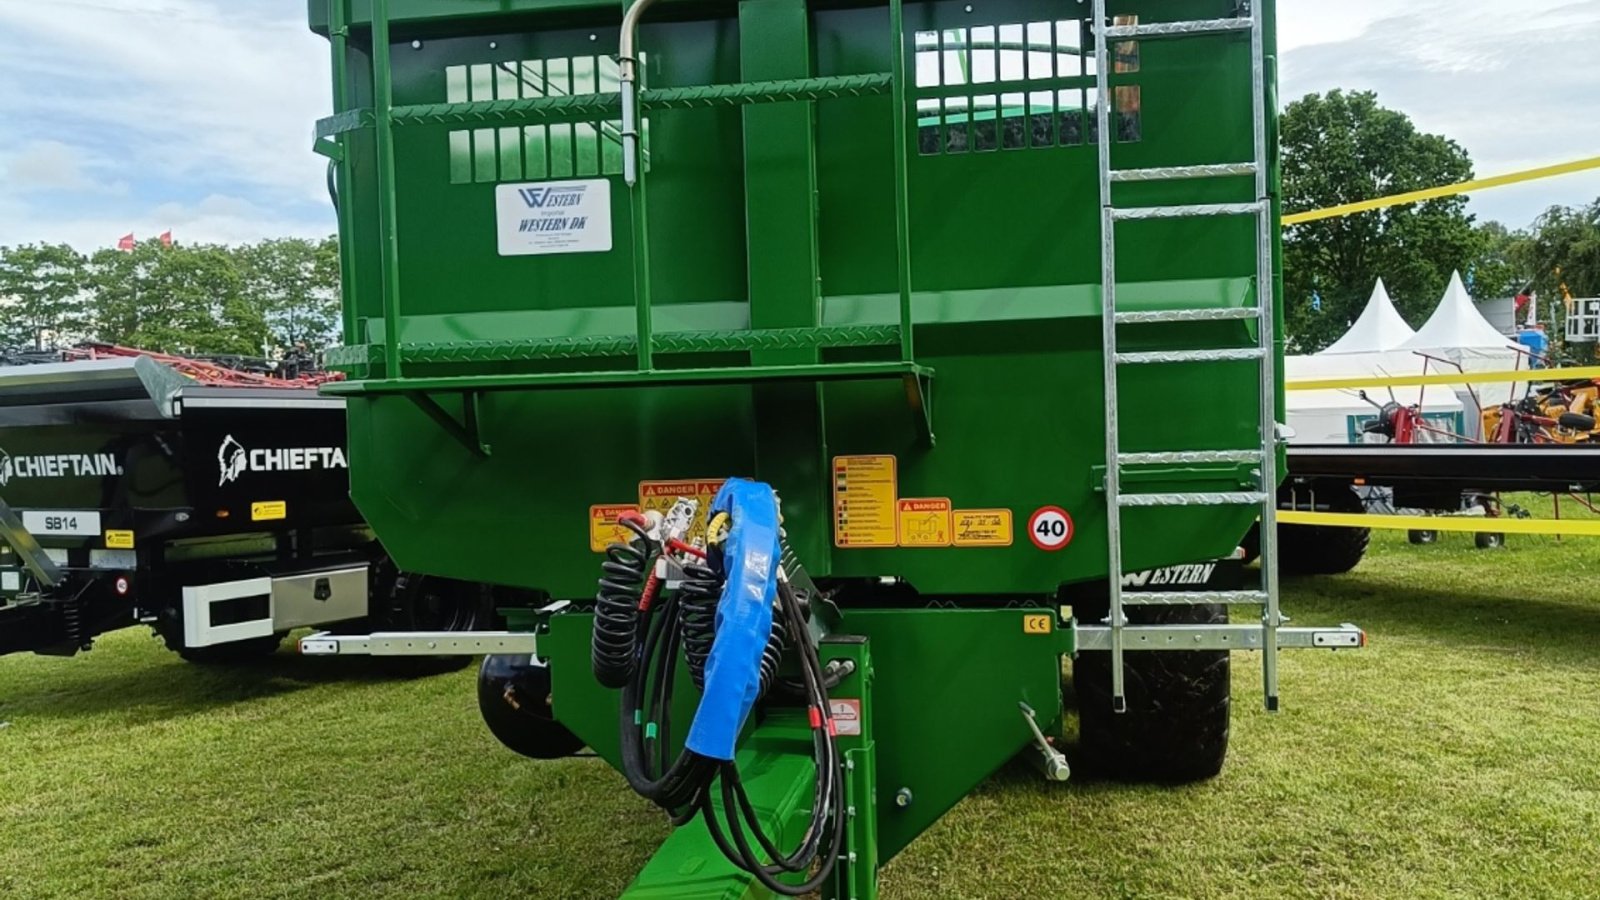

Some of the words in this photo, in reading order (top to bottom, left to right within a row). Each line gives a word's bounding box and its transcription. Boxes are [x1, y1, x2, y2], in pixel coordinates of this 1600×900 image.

[518, 186, 584, 208] WESTERN
[519, 217, 570, 232] WESTERN
[569, 216, 588, 230] DK
[249, 447, 348, 471] CHIEFTA
[657, 484, 695, 494] DANGER
[45, 517, 77, 530] SB14
[1036, 520, 1065, 537] 40
[1120, 563, 1216, 586] WESTERN
[1029, 618, 1046, 630] CE
